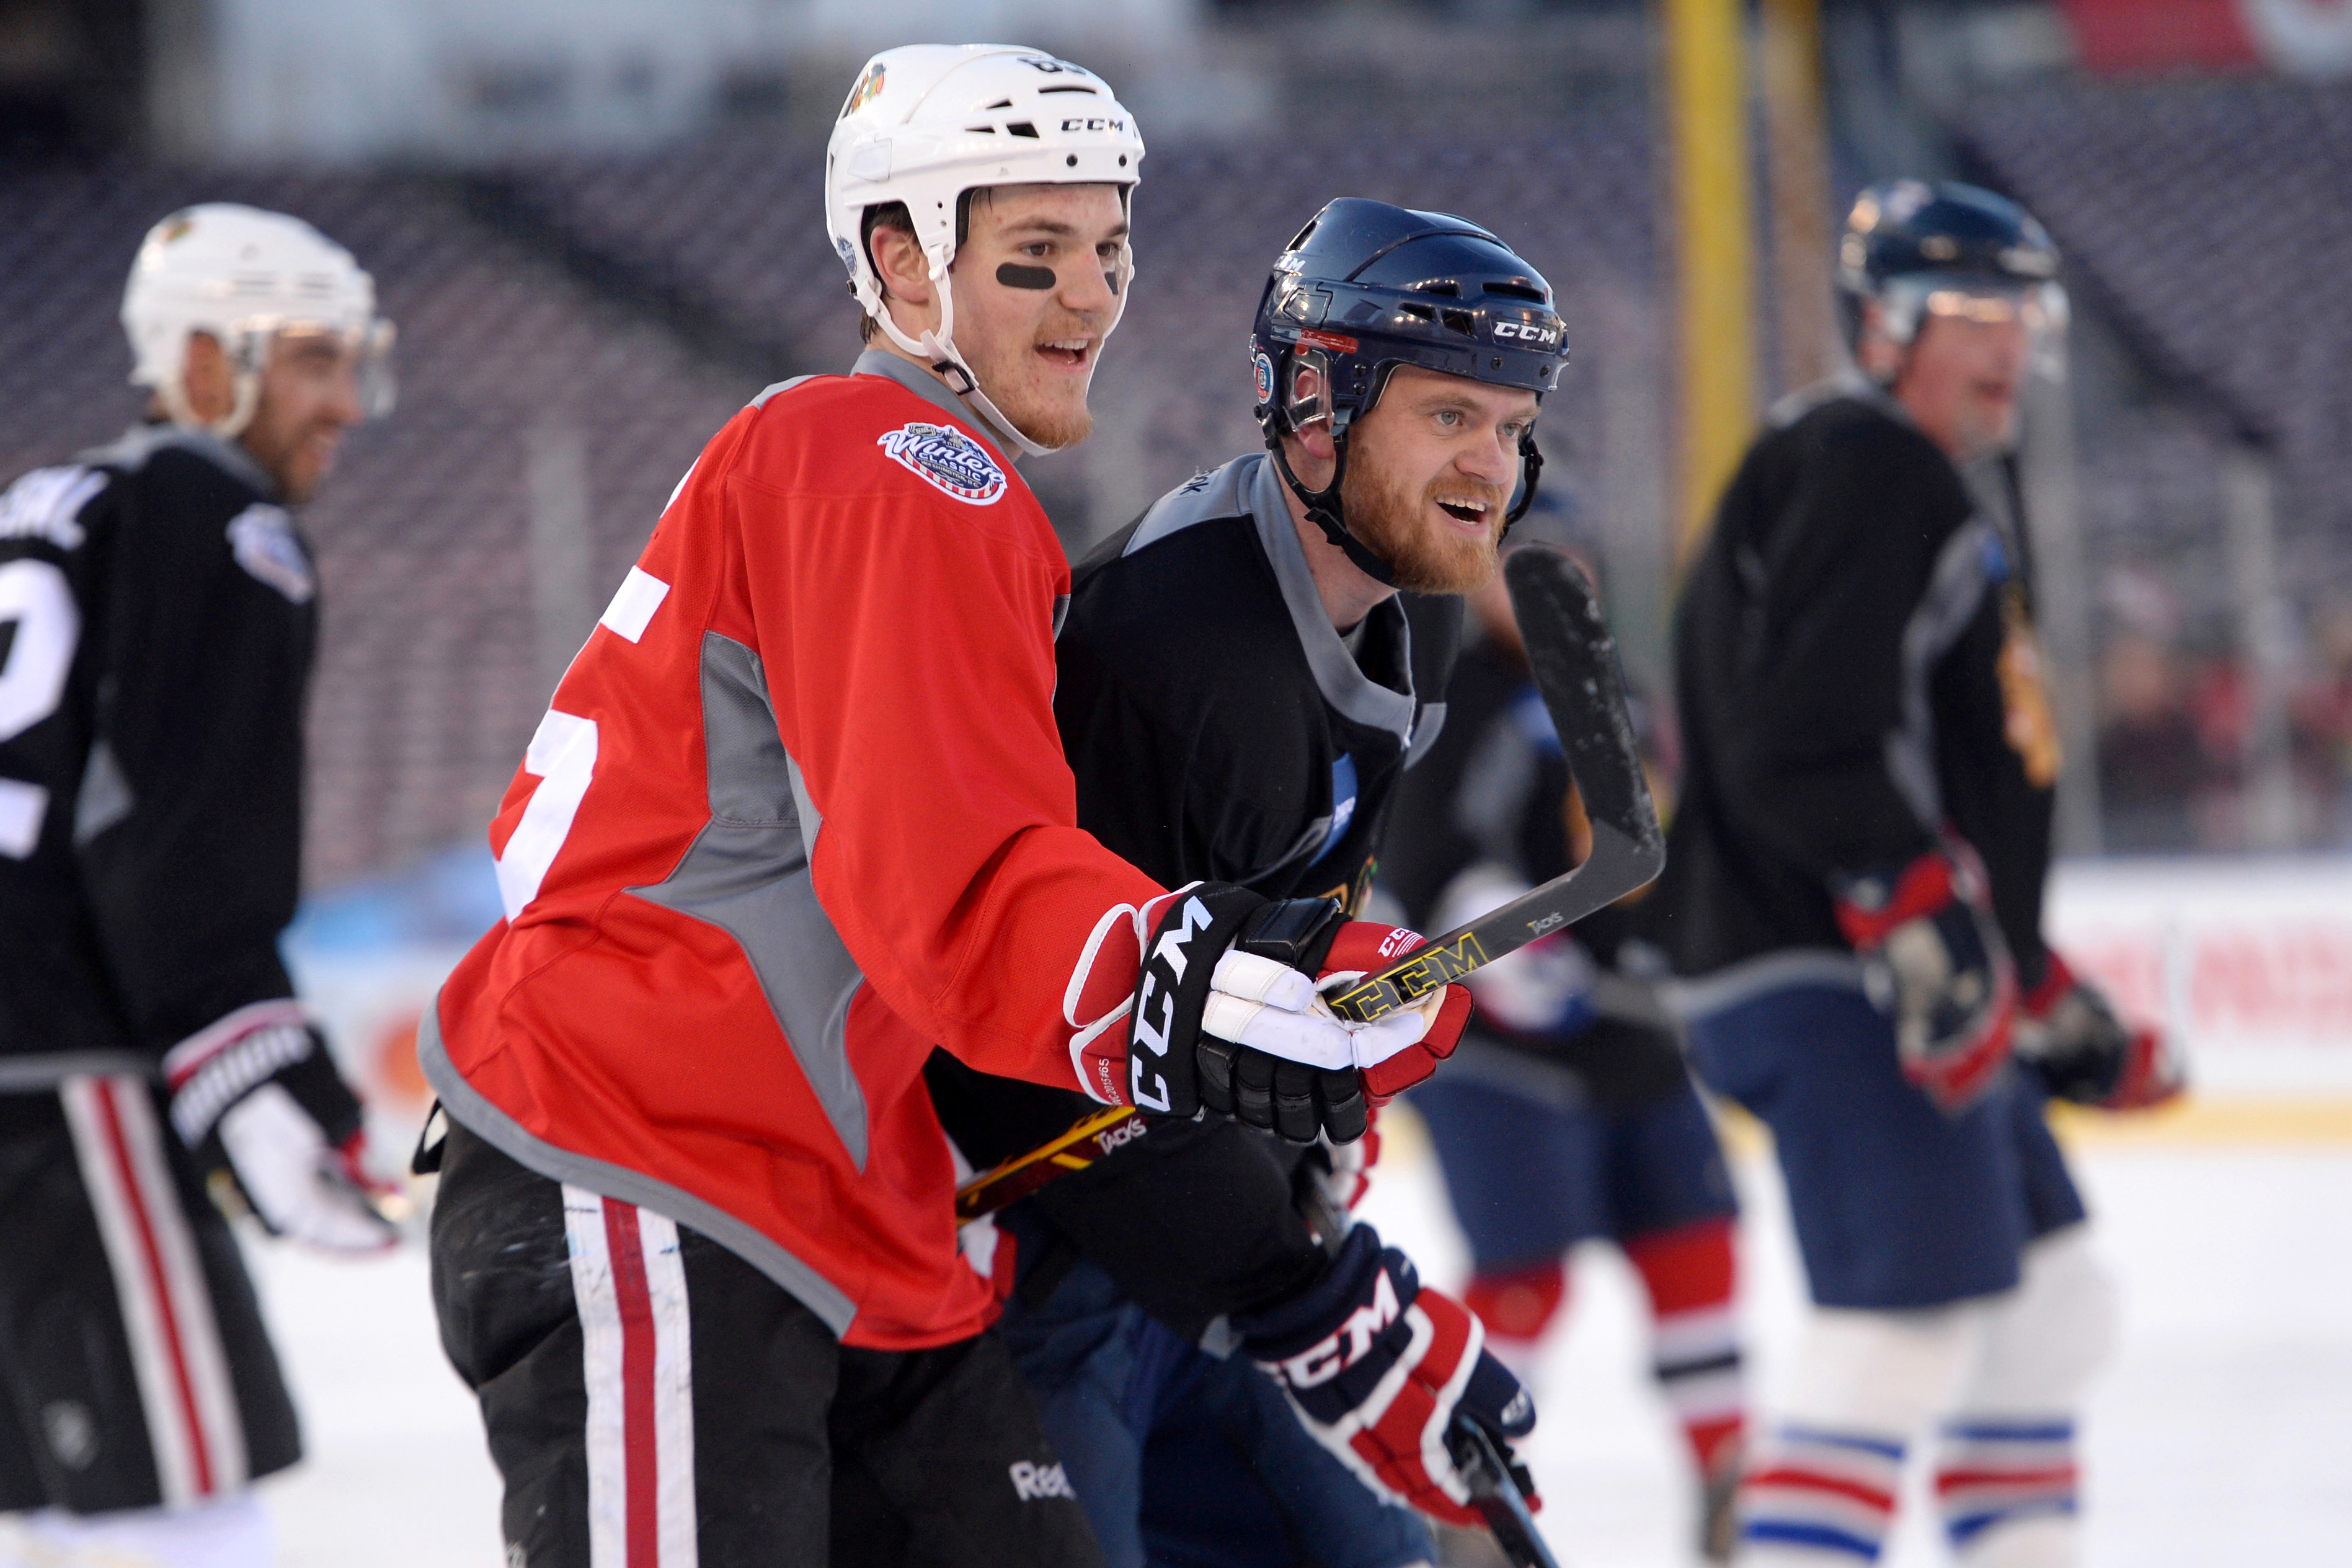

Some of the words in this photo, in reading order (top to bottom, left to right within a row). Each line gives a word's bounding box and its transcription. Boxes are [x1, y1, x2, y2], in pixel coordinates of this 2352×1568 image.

[1061, 118, 1124, 131] CCM
[1493, 321, 1556, 345] CCM
[881, 432, 1003, 484] Winter
[918, 451, 981, 482] CLASSIC
[1377, 928, 1413, 957] CC
[1331, 932, 1490, 1021] CCM
[1132, 895, 1214, 1112] CCM
